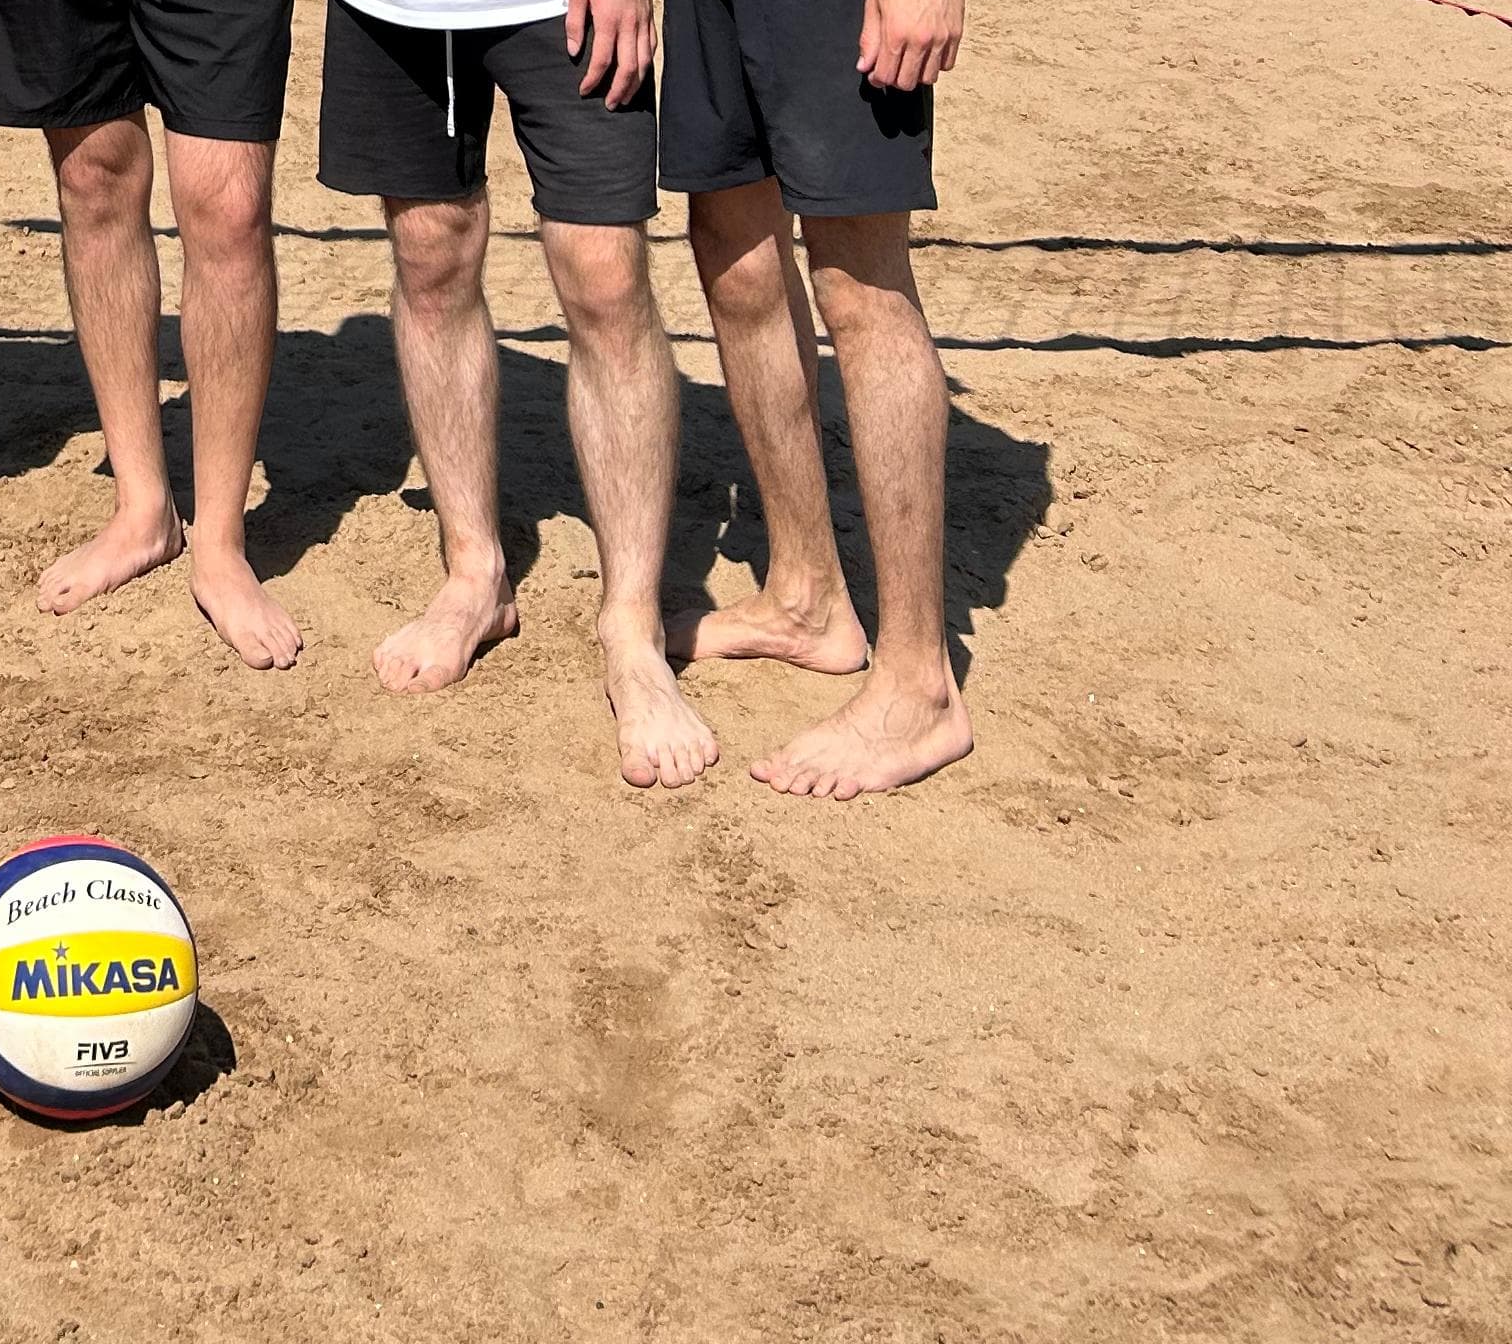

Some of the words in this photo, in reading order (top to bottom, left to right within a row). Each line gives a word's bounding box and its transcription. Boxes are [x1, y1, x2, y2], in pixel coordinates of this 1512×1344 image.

[7, 881, 76, 925] Beach
[86, 879, 162, 910] Classic
[77, 1039, 129, 1061] FIVB
